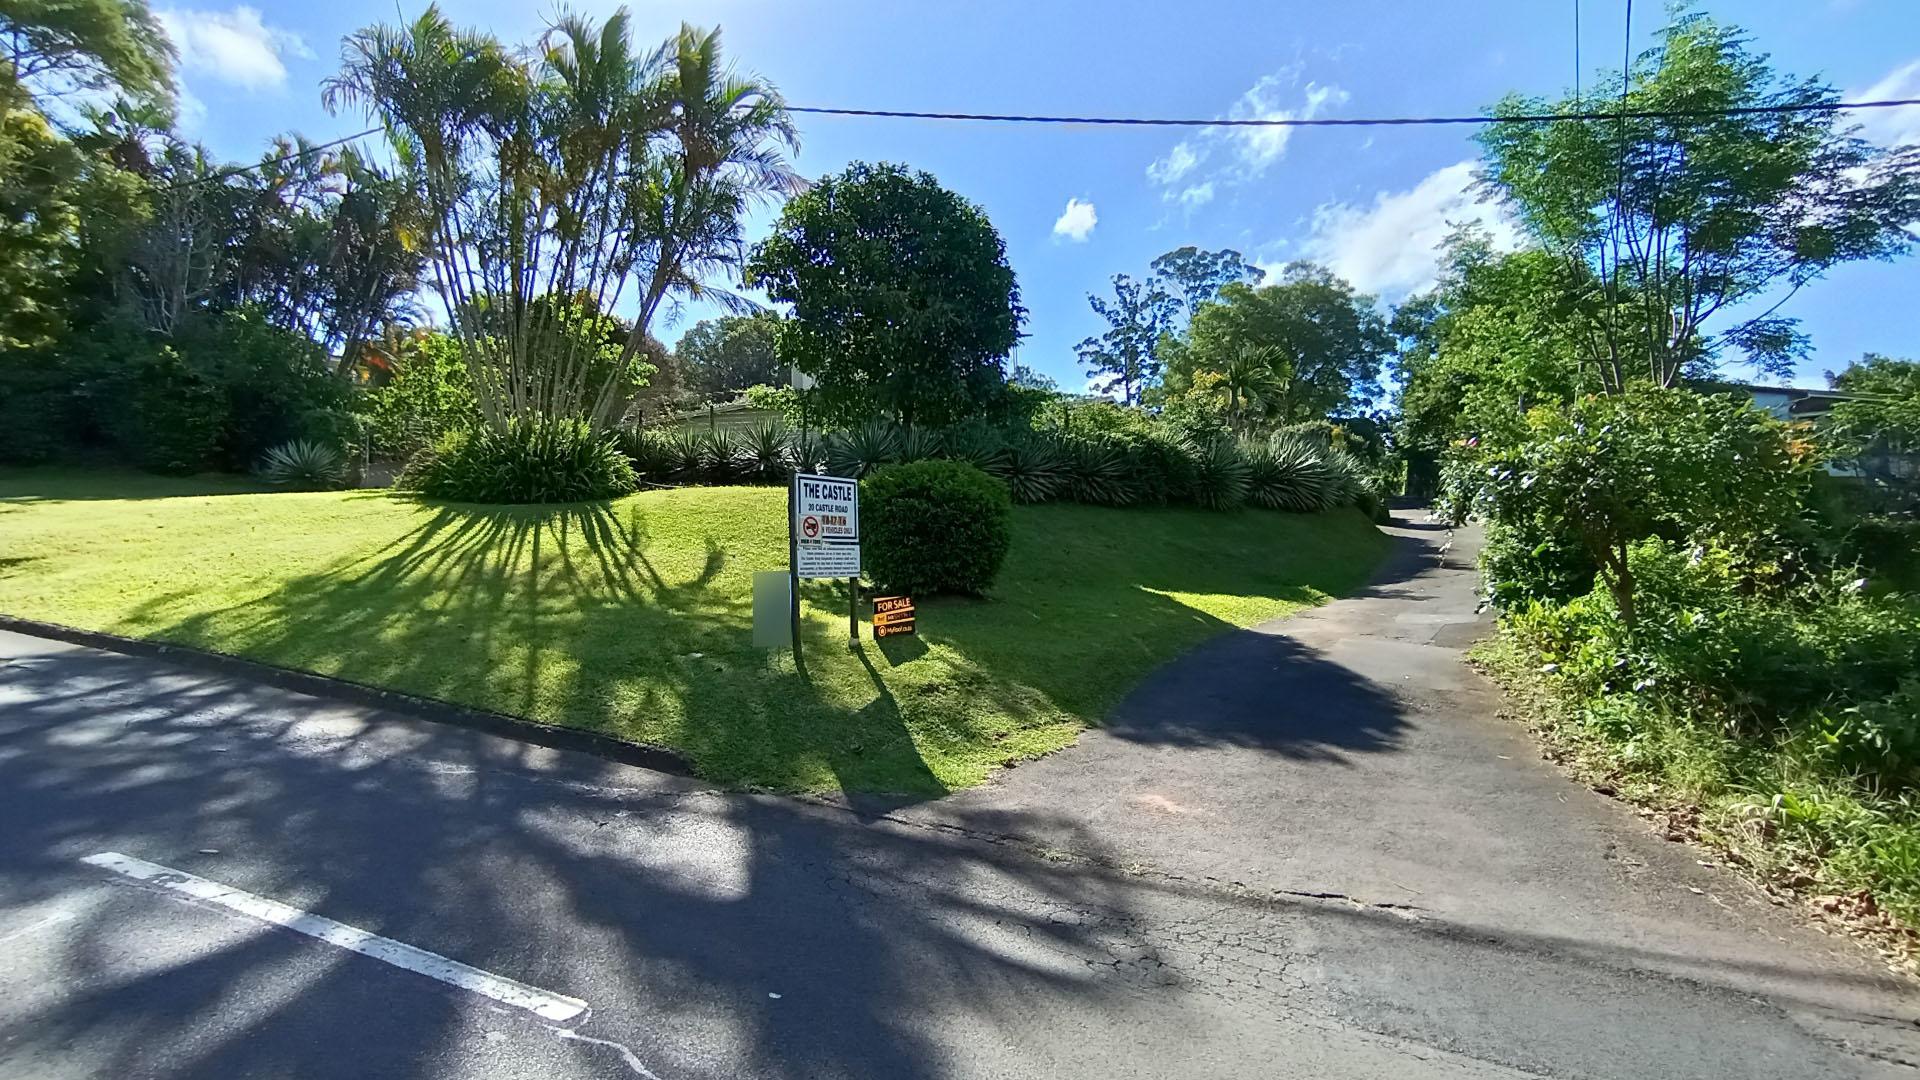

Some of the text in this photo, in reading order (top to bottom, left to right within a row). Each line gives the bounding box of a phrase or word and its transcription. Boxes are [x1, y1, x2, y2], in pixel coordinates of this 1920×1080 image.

[804, 482, 852, 501] THE CASTLE
[808, 503, 848, 513] 20 CASTLE ROAD
[877, 597, 911, 612] FOR SALE
